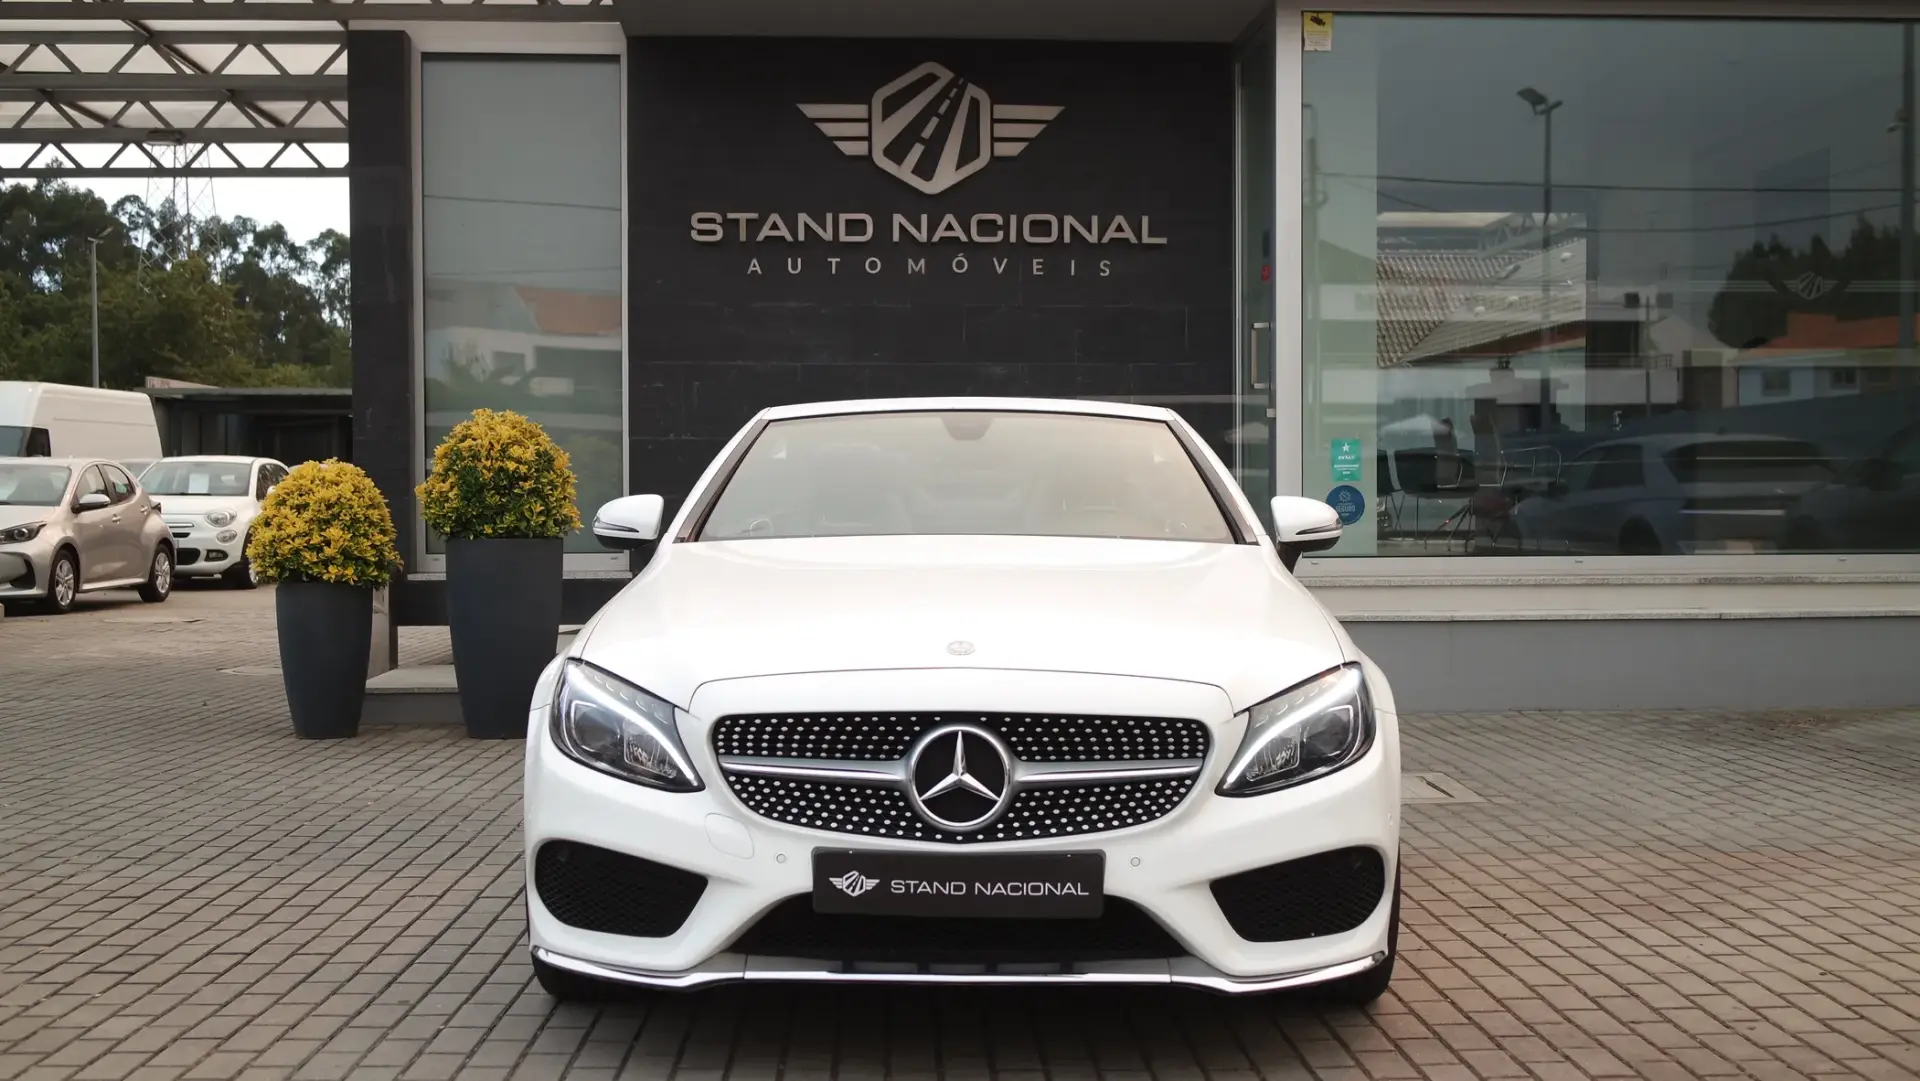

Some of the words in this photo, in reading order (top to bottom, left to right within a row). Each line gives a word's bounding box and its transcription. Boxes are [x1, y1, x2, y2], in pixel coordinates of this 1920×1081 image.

[690, 212, 874, 243] STAND
[892, 213, 1168, 244] NACIONAL
[746, 253, 1112, 277] AUTOMÓVEIS
[890, 879, 967, 895] STAND
[974, 881, 1090, 896] NACIONAL
